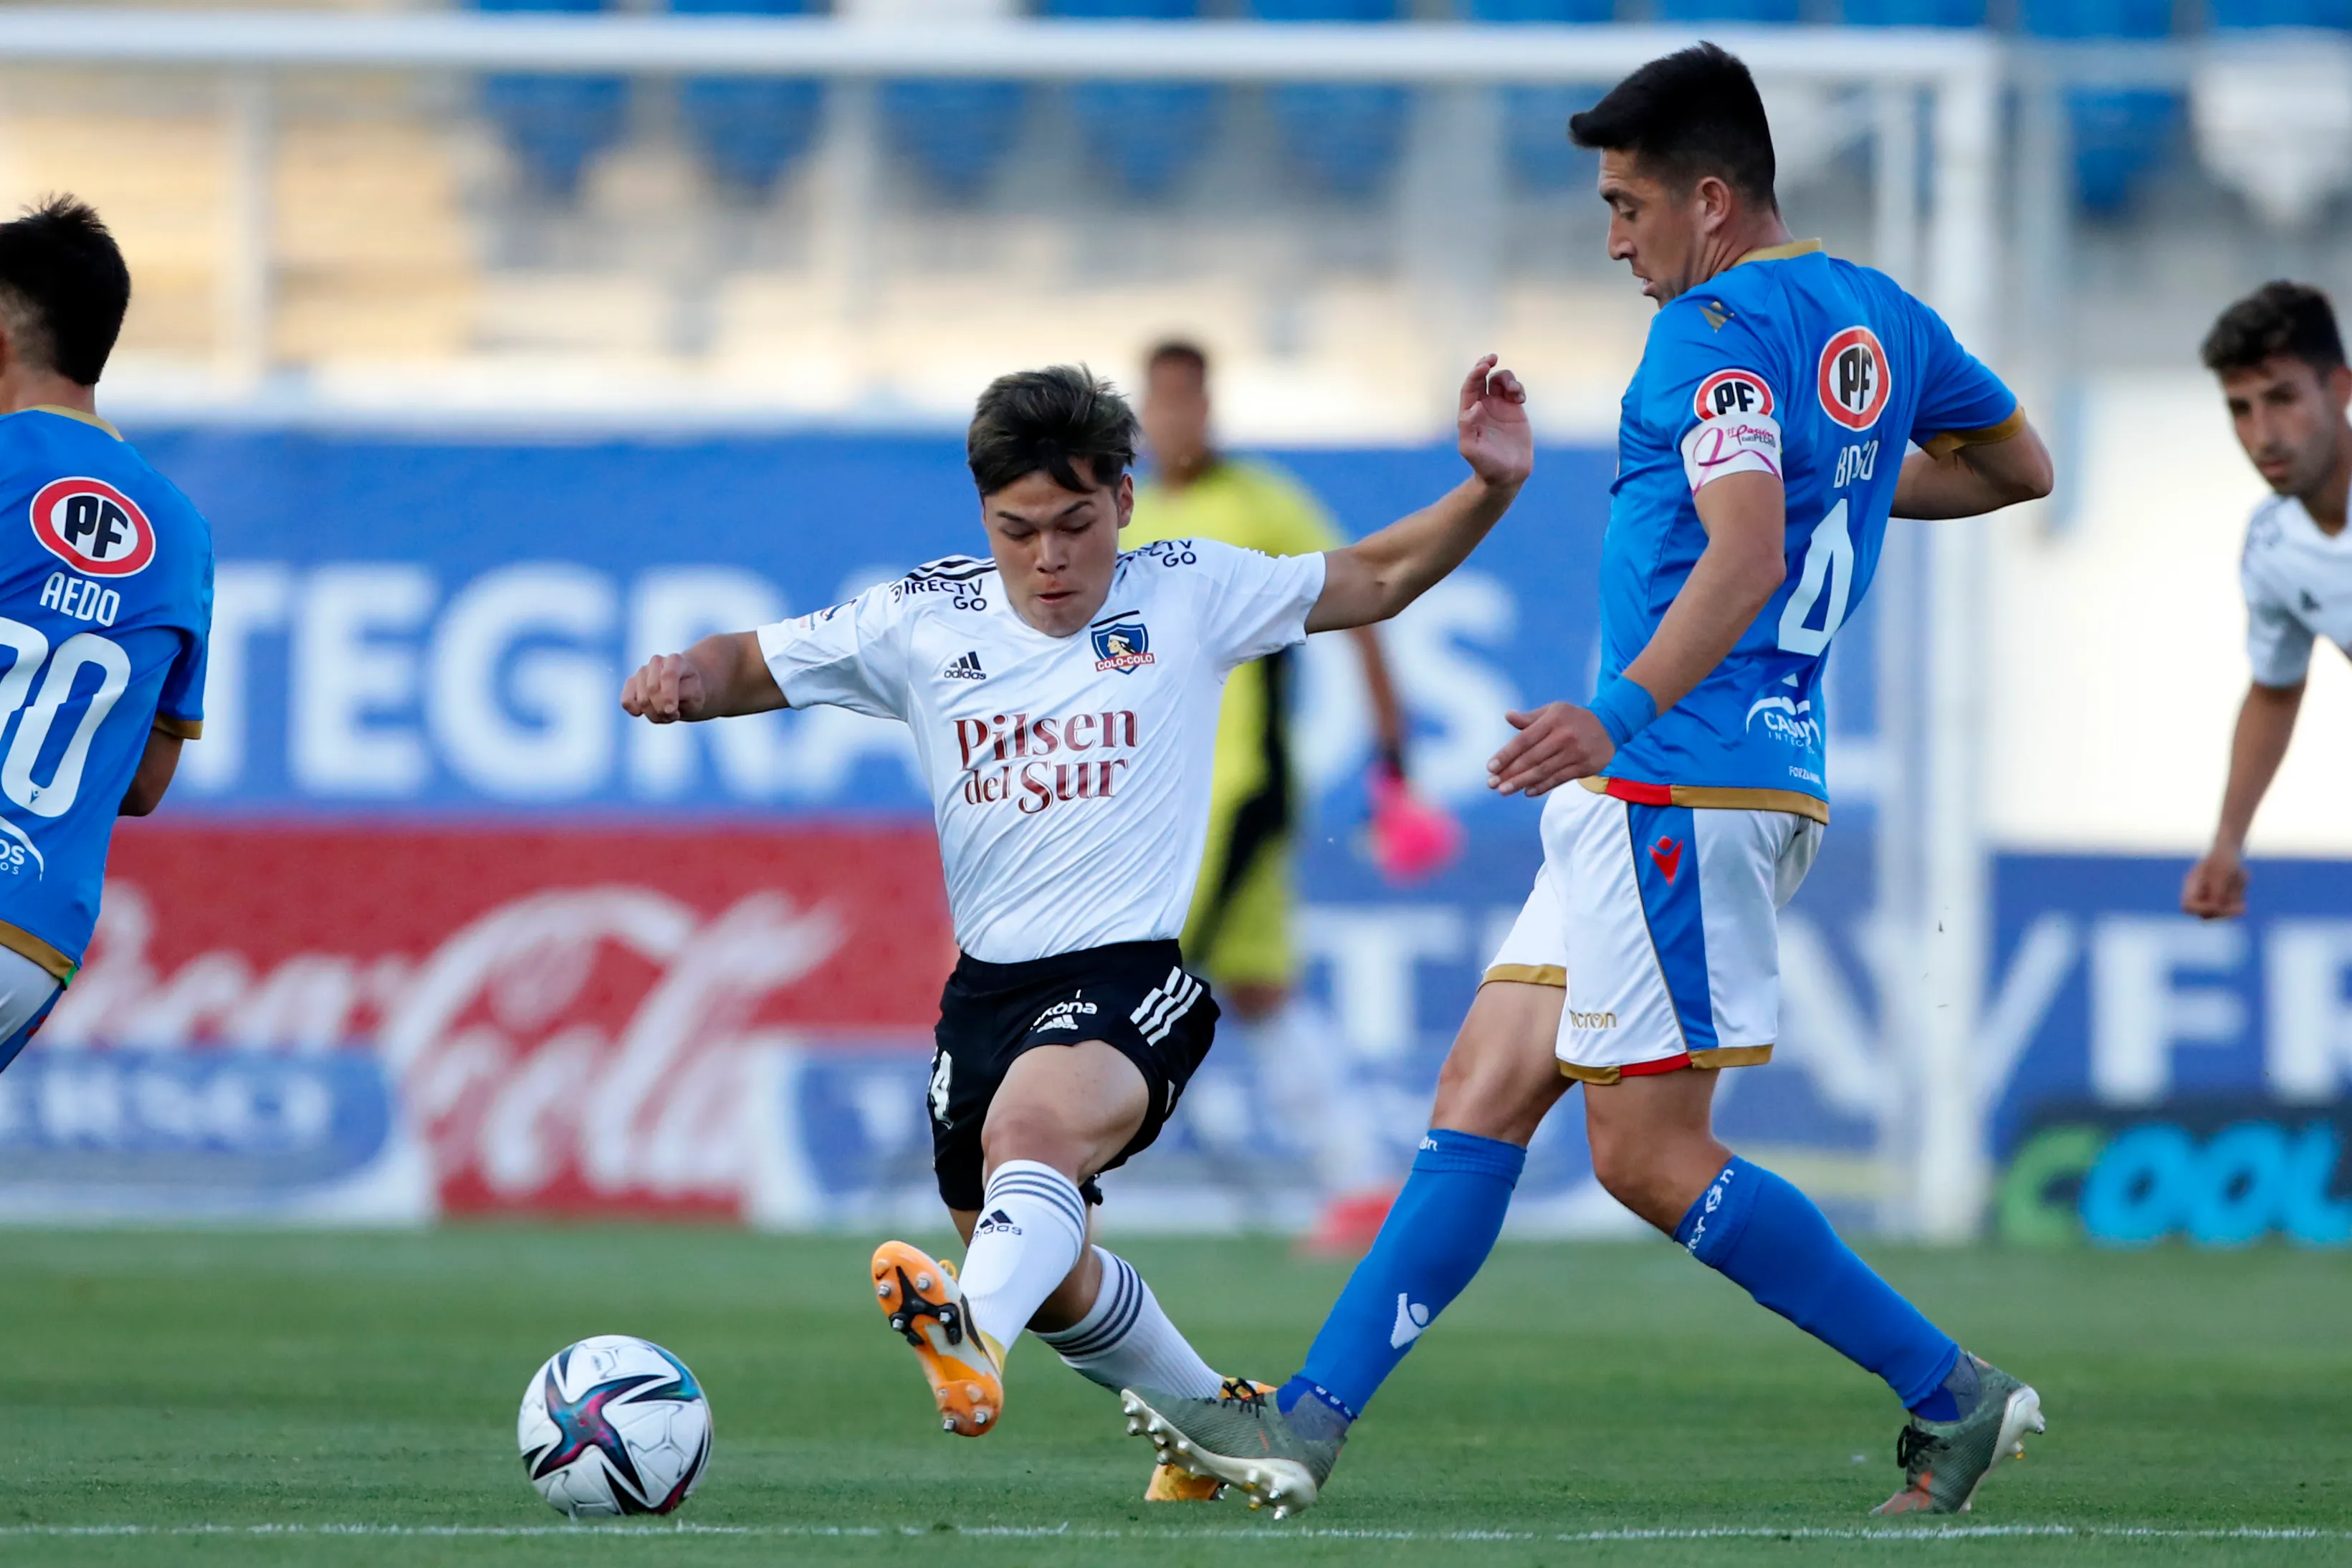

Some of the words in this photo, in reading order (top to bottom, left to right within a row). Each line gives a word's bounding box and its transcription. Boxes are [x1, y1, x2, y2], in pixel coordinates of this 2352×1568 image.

[1713, 381, 1754, 415] PF
[1839, 346, 1873, 411] PF
[64, 495, 128, 558] PF
[1162, 551, 1197, 568] GO
[39, 571, 120, 627] AEDO
[953, 596, 988, 611] GO
[1778, 498, 1855, 687] 4
[944, 668, 987, 680] adidas
[1097, 655, 1154, 670] COLO-COLO
[953, 709, 1139, 771] Pilsen
[965, 765, 1013, 805] del
[1018, 759, 1129, 814] Sur
[1998, 1119, 2352, 1251] COOL
